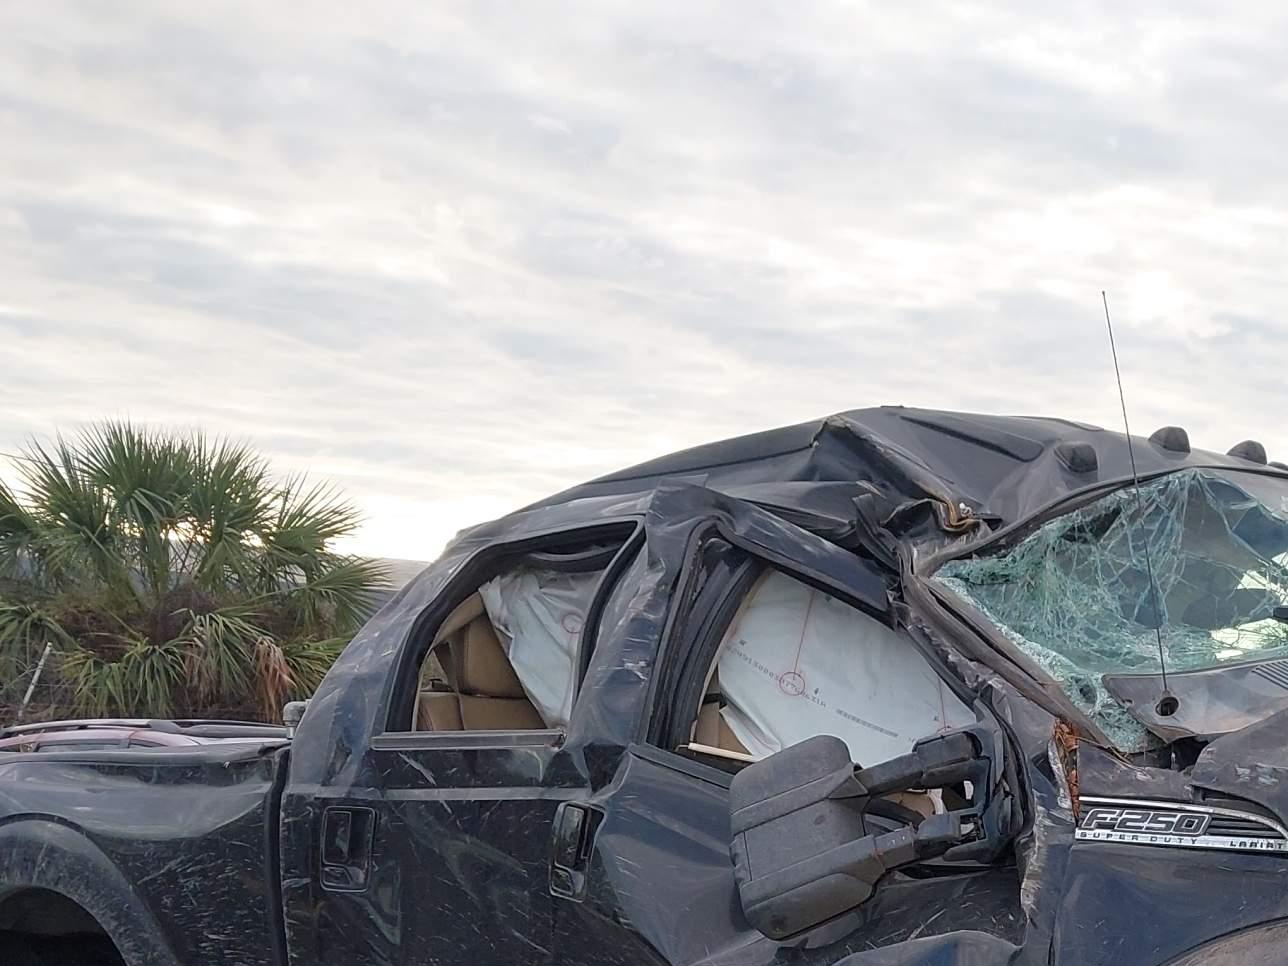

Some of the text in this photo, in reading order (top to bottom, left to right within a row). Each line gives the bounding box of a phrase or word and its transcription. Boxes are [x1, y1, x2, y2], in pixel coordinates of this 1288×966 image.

[1080, 831, 1199, 845] SUPER DUTY
[1229, 841, 1284, 850] LARIAT
